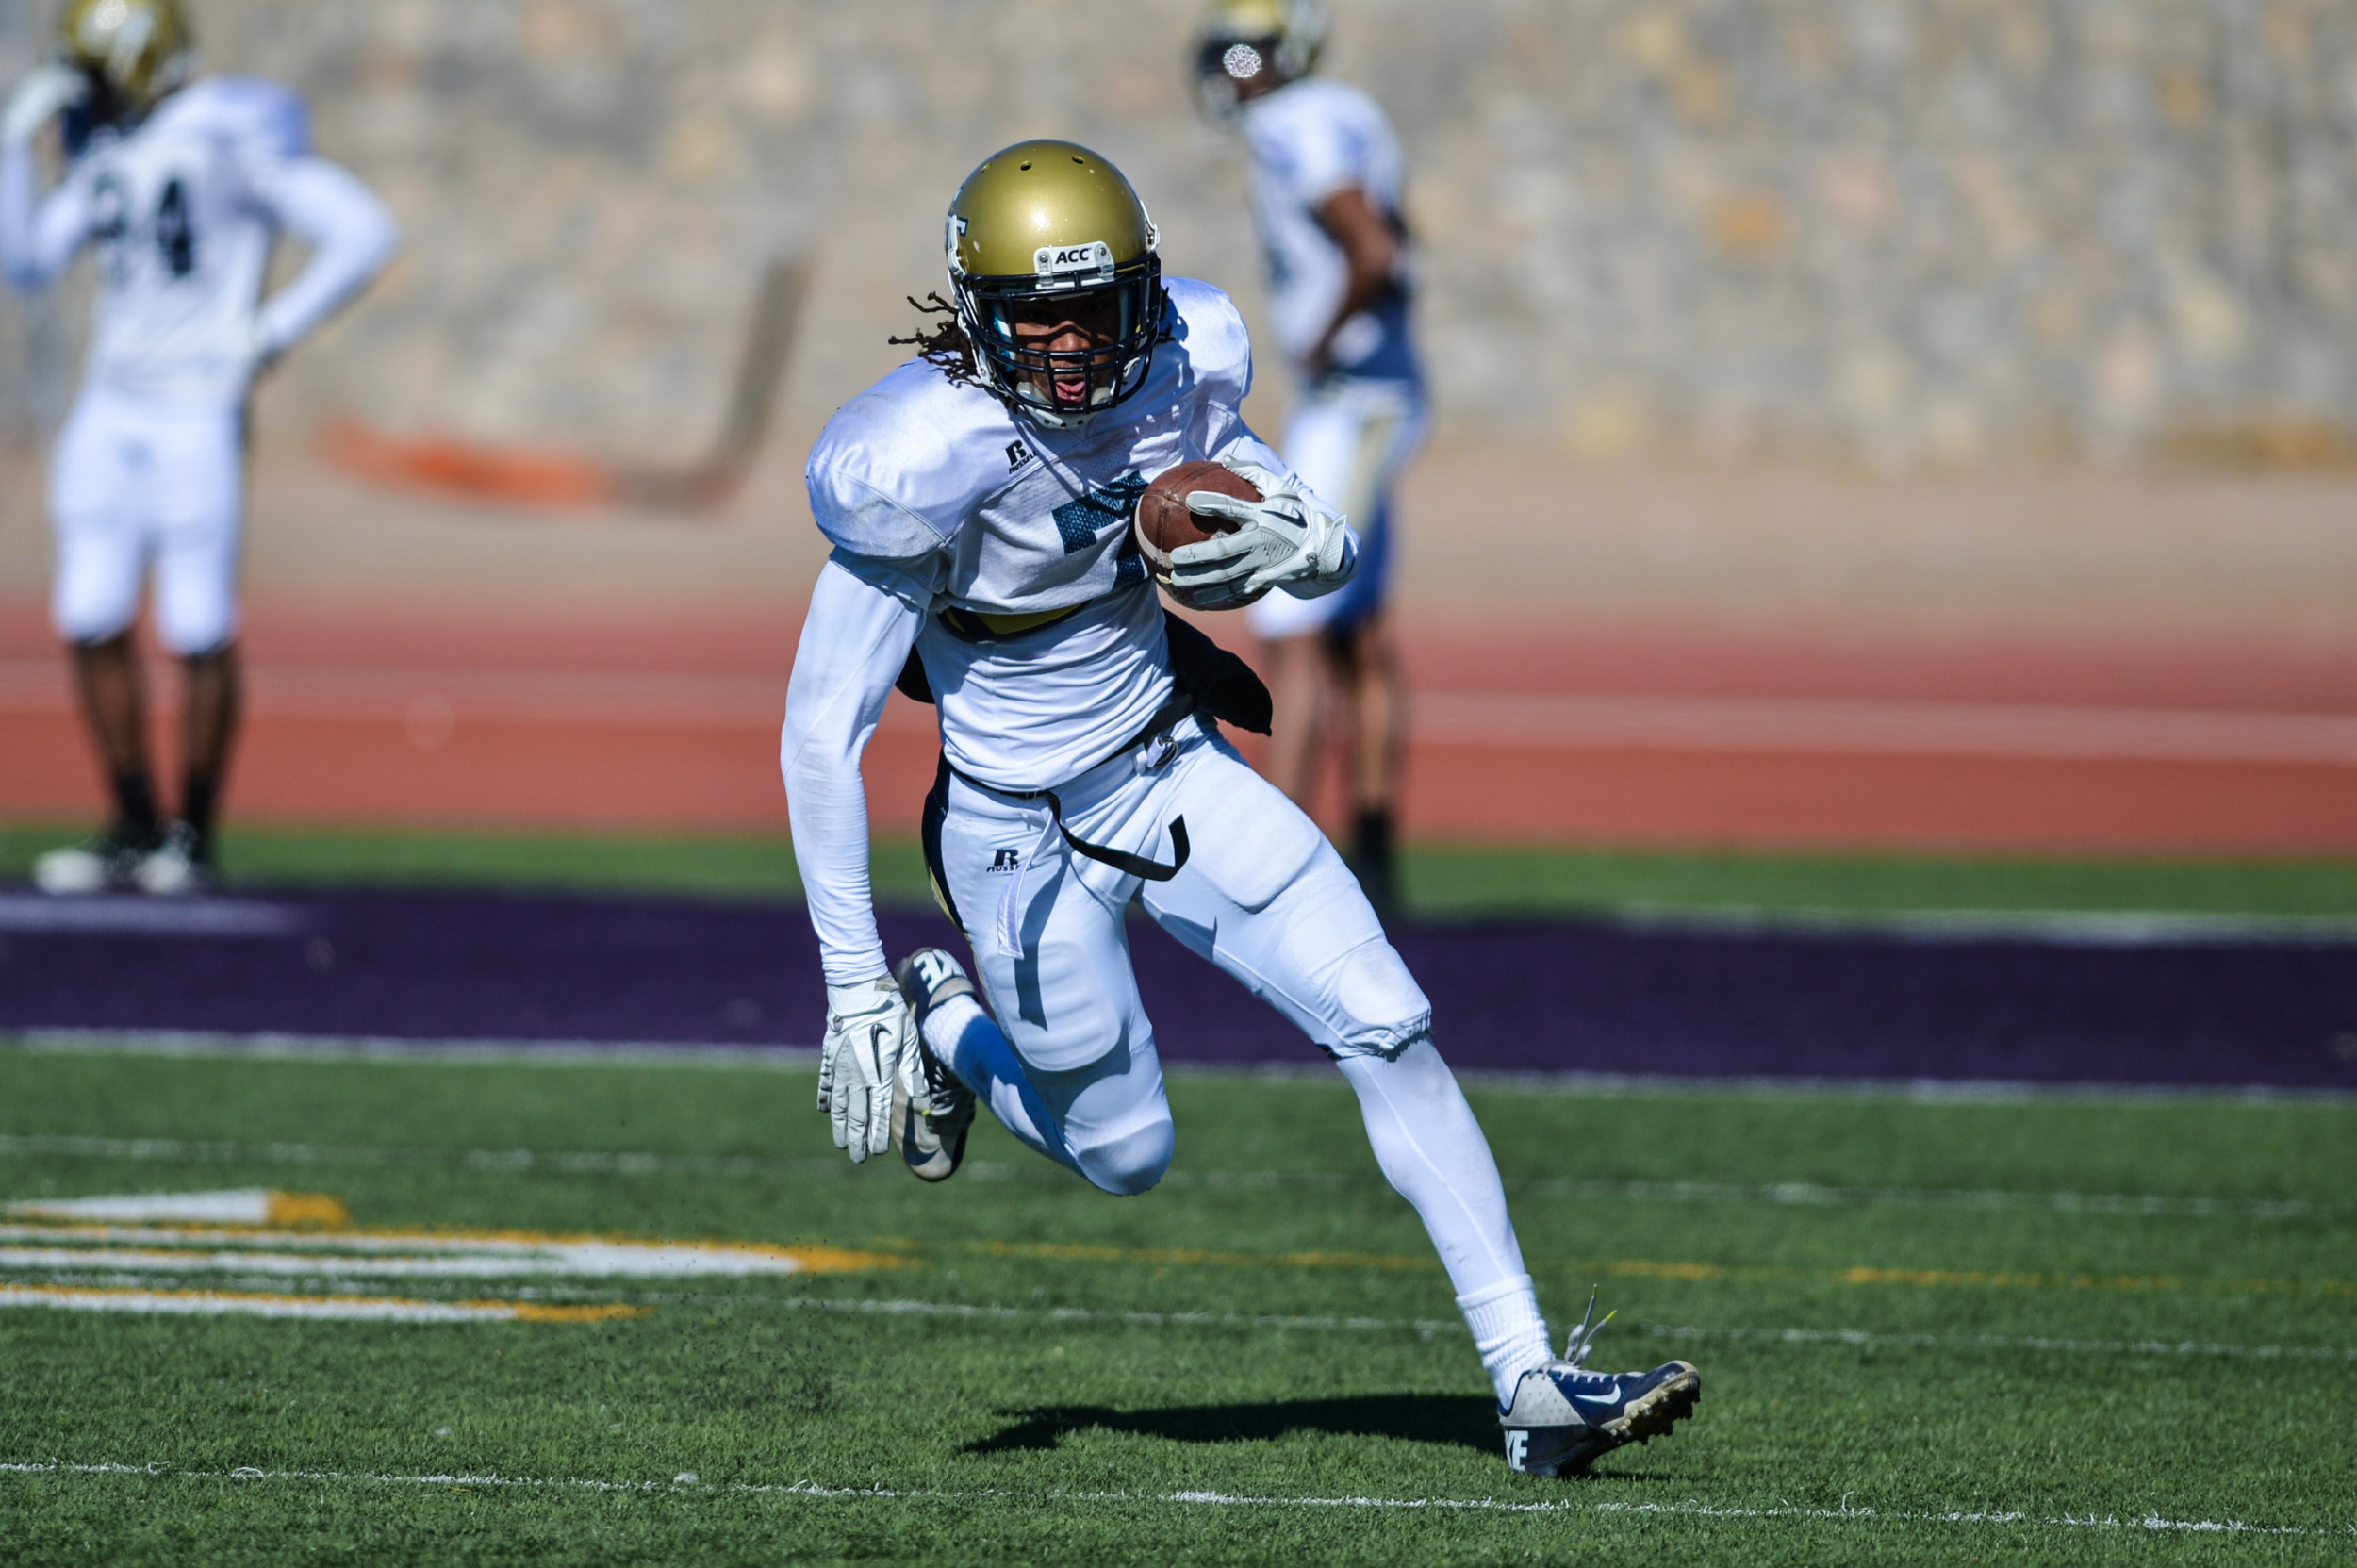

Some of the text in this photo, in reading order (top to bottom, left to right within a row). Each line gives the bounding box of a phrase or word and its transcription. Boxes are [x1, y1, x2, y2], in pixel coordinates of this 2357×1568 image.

[1055, 247, 1090, 264] ACC
[1005, 439, 1028, 466] R
[994, 849, 1019, 866] R
